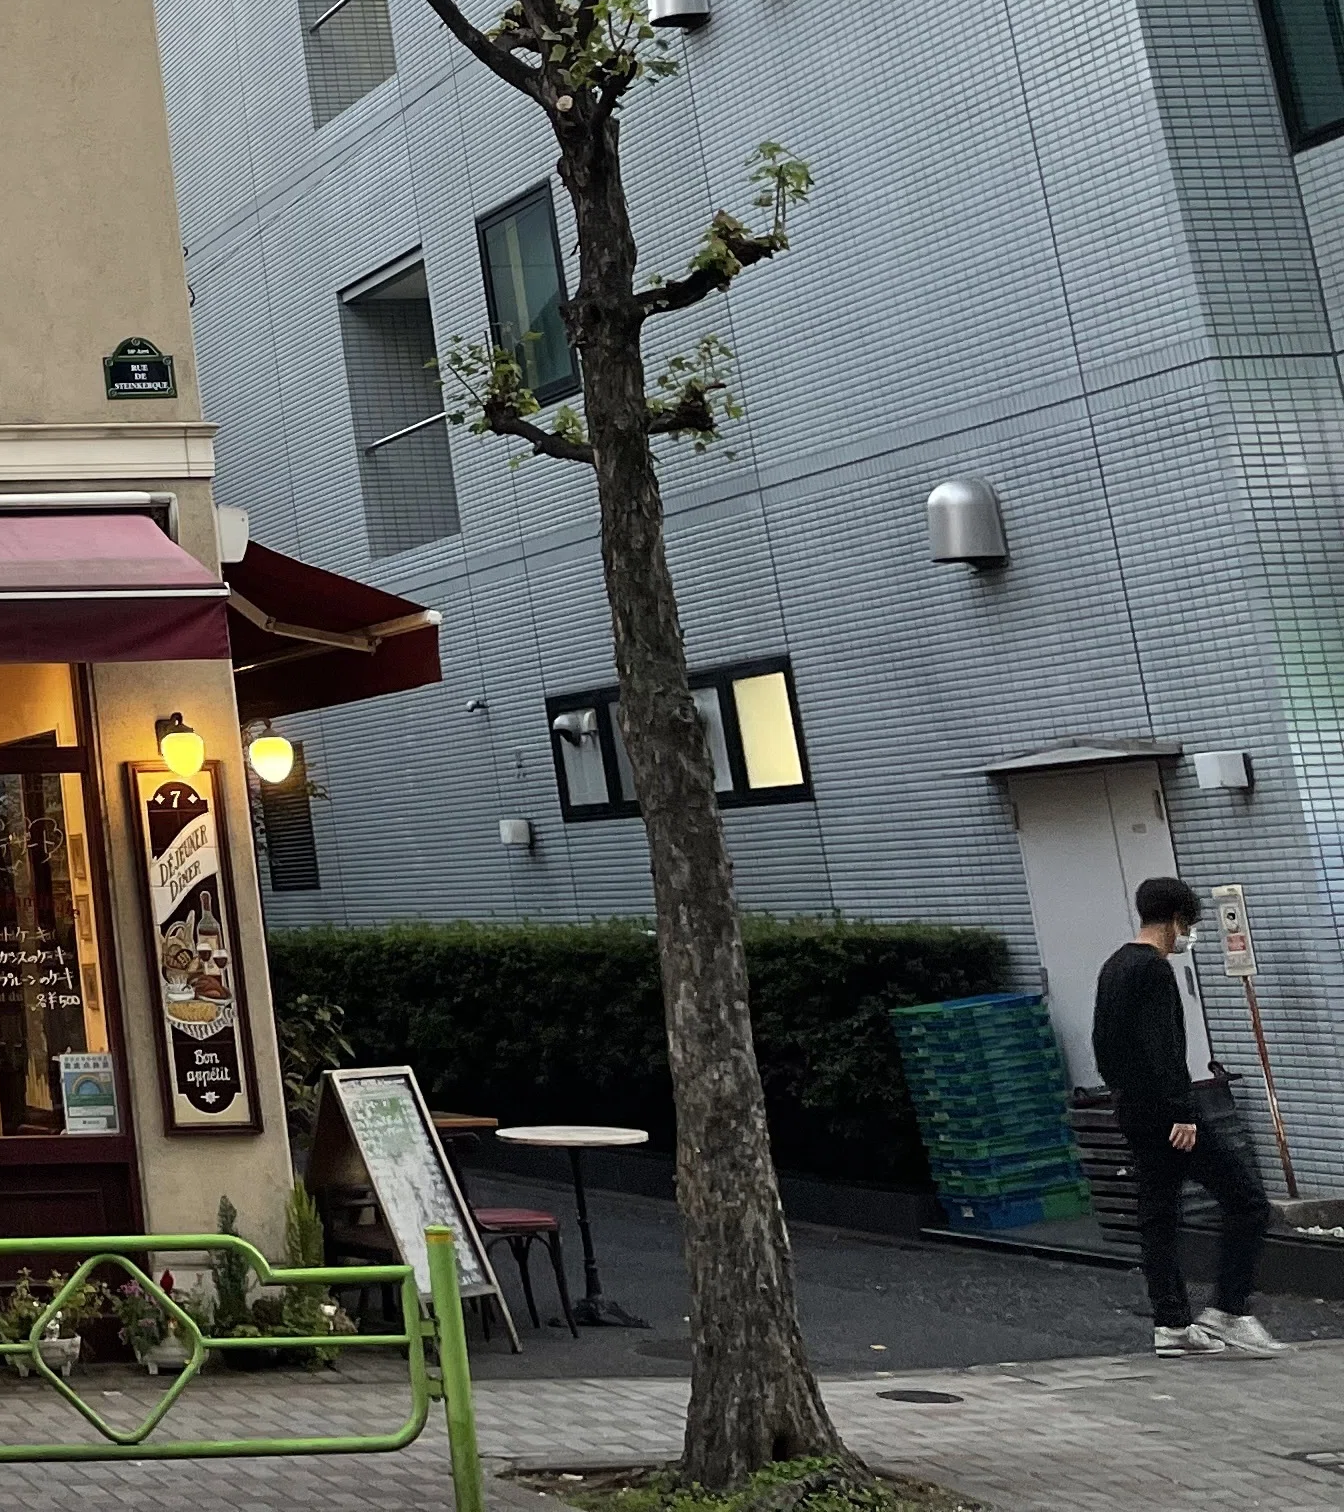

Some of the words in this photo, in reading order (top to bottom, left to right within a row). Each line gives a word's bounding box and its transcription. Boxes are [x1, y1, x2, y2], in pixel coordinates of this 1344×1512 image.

[130, 364, 149, 372] RUE
[134, 372, 147, 380] DE
[114, 381, 169, 391] STEINKERQUE
[170, 790, 181, 808] 7
[159, 824, 207, 887] DÉJEUNER
[194, 1049, 220, 1065] Bon
